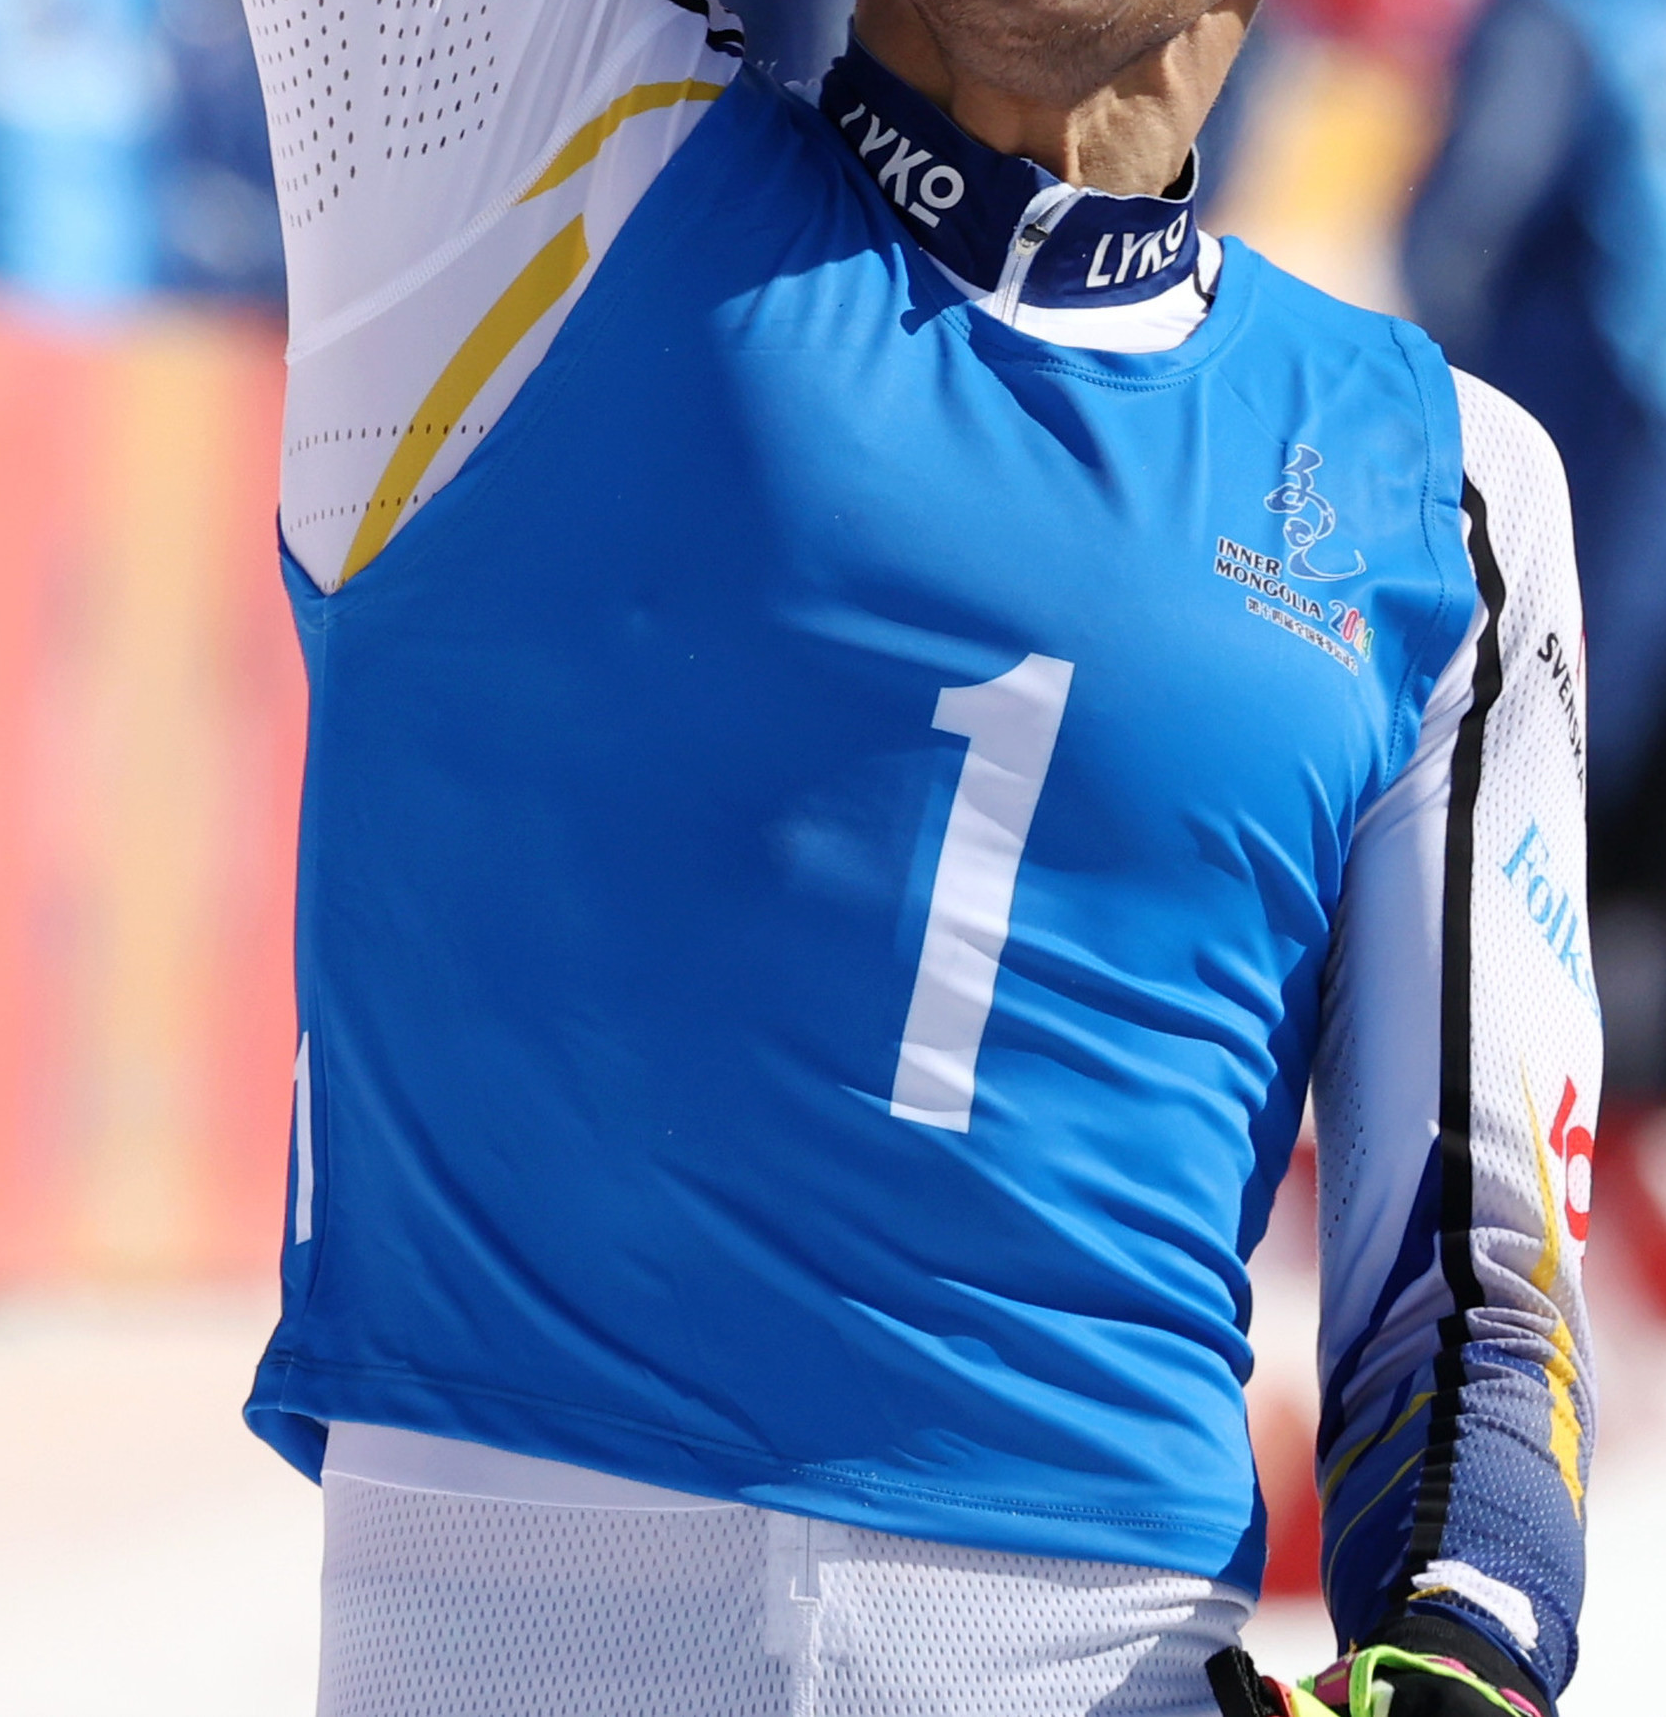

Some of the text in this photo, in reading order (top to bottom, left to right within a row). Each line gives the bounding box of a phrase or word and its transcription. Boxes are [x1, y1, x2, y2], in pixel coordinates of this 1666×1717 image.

[1084, 209, 1189, 289] LYKO
[1214, 556, 1325, 623] MONGOLIA
[1217, 536, 1283, 578] INNER
[890, 652, 1075, 1134] 1
